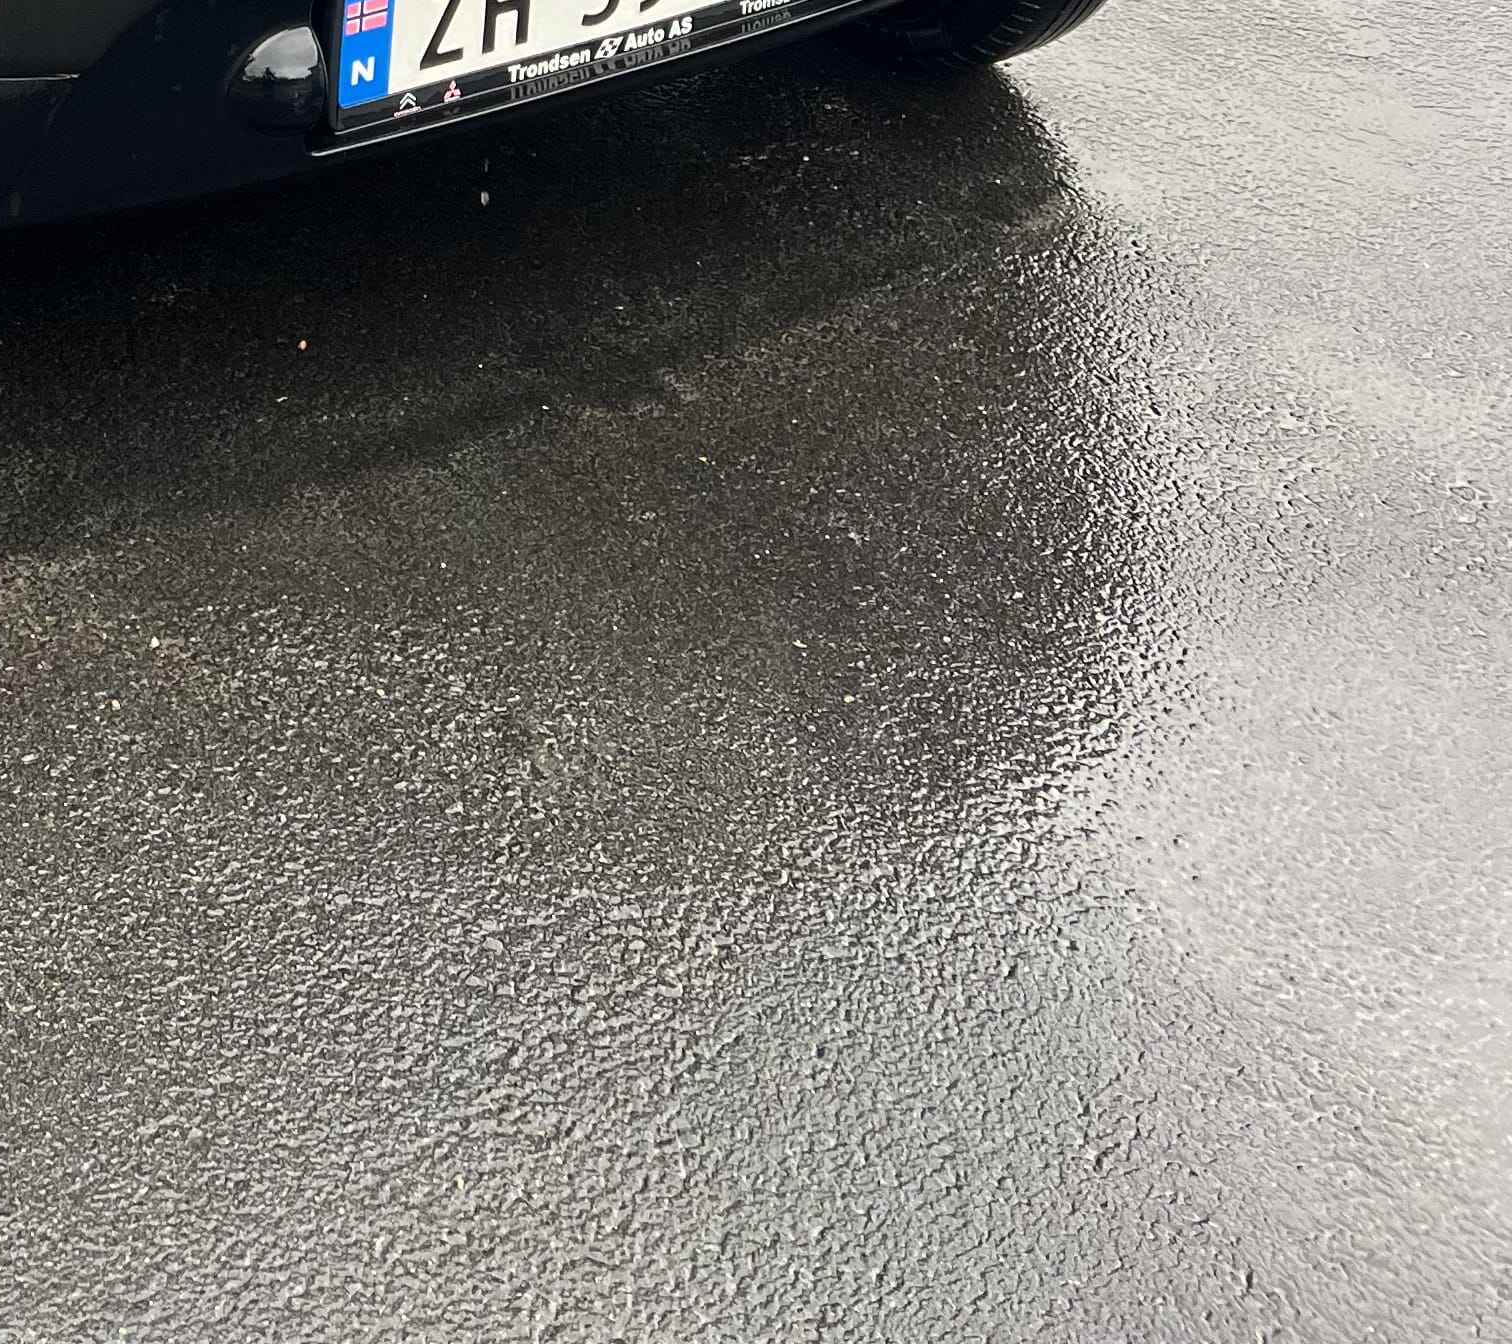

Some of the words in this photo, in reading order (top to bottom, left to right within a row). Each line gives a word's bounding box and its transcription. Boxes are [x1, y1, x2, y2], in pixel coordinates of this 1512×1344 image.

[349, 55, 376, 86] N
[507, 47, 591, 83] Trondsen
[623, 25, 665, 52] Auto
[668, 16, 693, 39] AS
